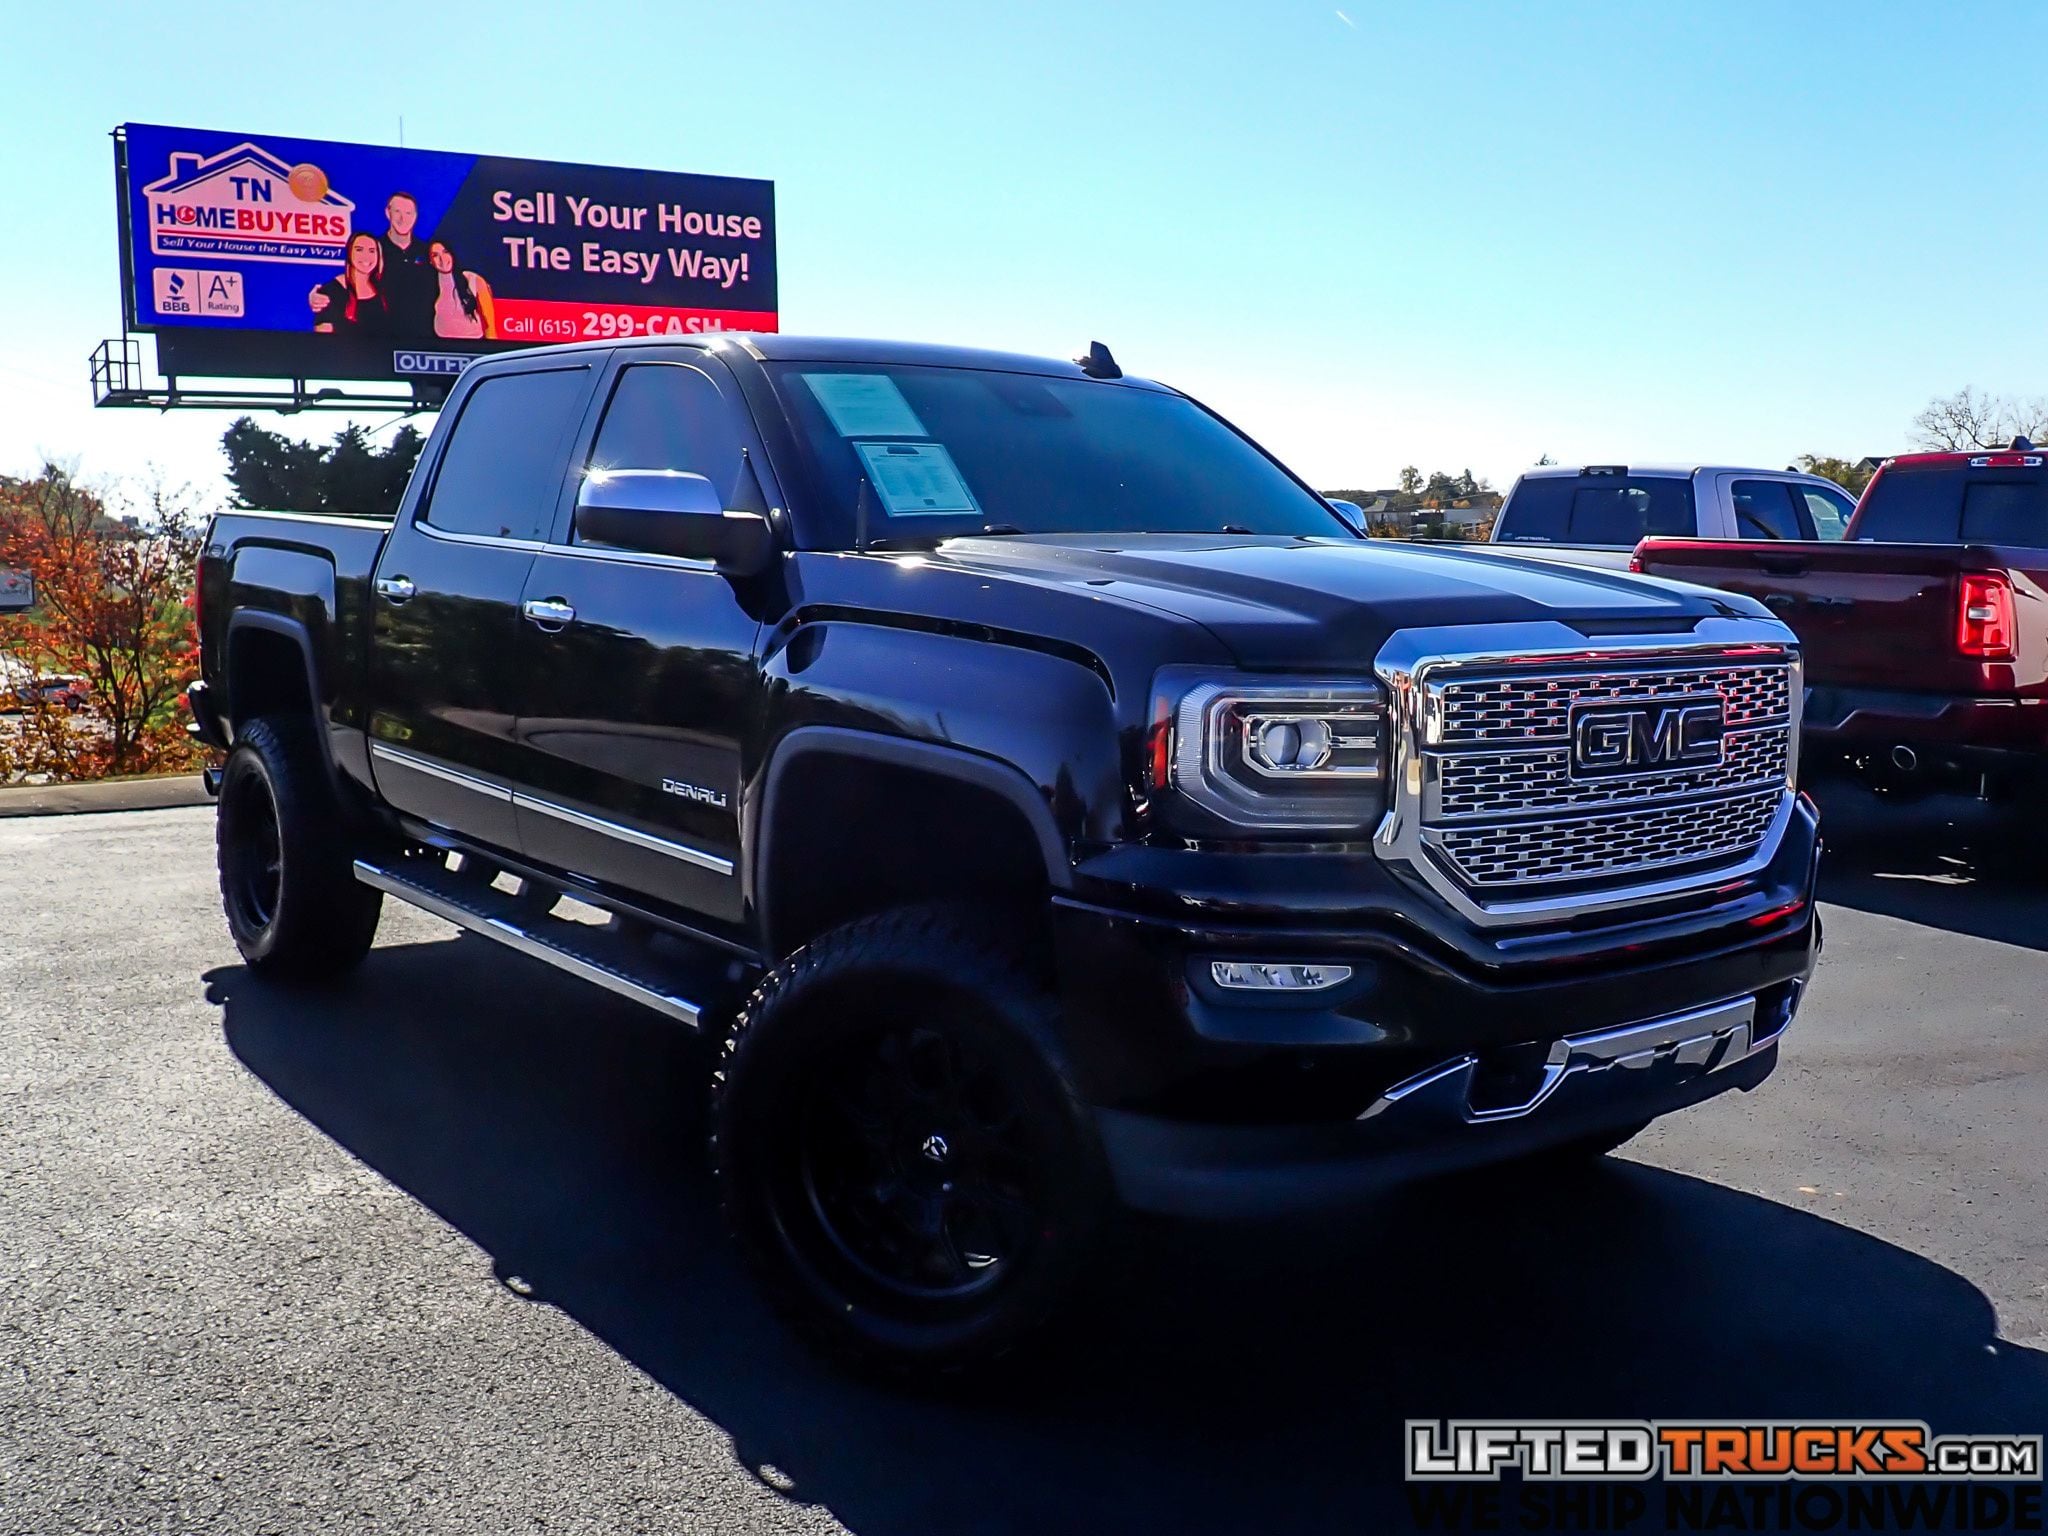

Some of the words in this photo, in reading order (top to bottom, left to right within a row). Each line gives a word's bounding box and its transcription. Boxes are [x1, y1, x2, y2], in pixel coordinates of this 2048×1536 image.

[229, 176, 272, 202] TN
[157, 204, 346, 236] HOMEBUYERS
[492, 190, 555, 225] Sell
[565, 195, 647, 231] Your
[657, 203, 762, 239] House
[162, 237, 184, 248] Sell
[187, 239, 215, 250] Your
[218, 241, 256, 253] House
[259, 243, 278, 254] the
[280, 245, 308, 258] Easy
[310, 247, 342, 258] Way!
[502, 236, 571, 270] The
[582, 242, 661, 284] Easy
[667, 248, 749, 289] Way!
[208, 274, 238, 299] A+
[162, 301, 190, 312] BBB
[207, 301, 240, 314] Rating
[503, 317, 534, 334] Call
[538, 318, 577, 337] (615)
[582, 311, 722, 336] 299-CASH
[1577, 704, 1722, 769] GMC
[662, 778, 727, 808] DENALI
